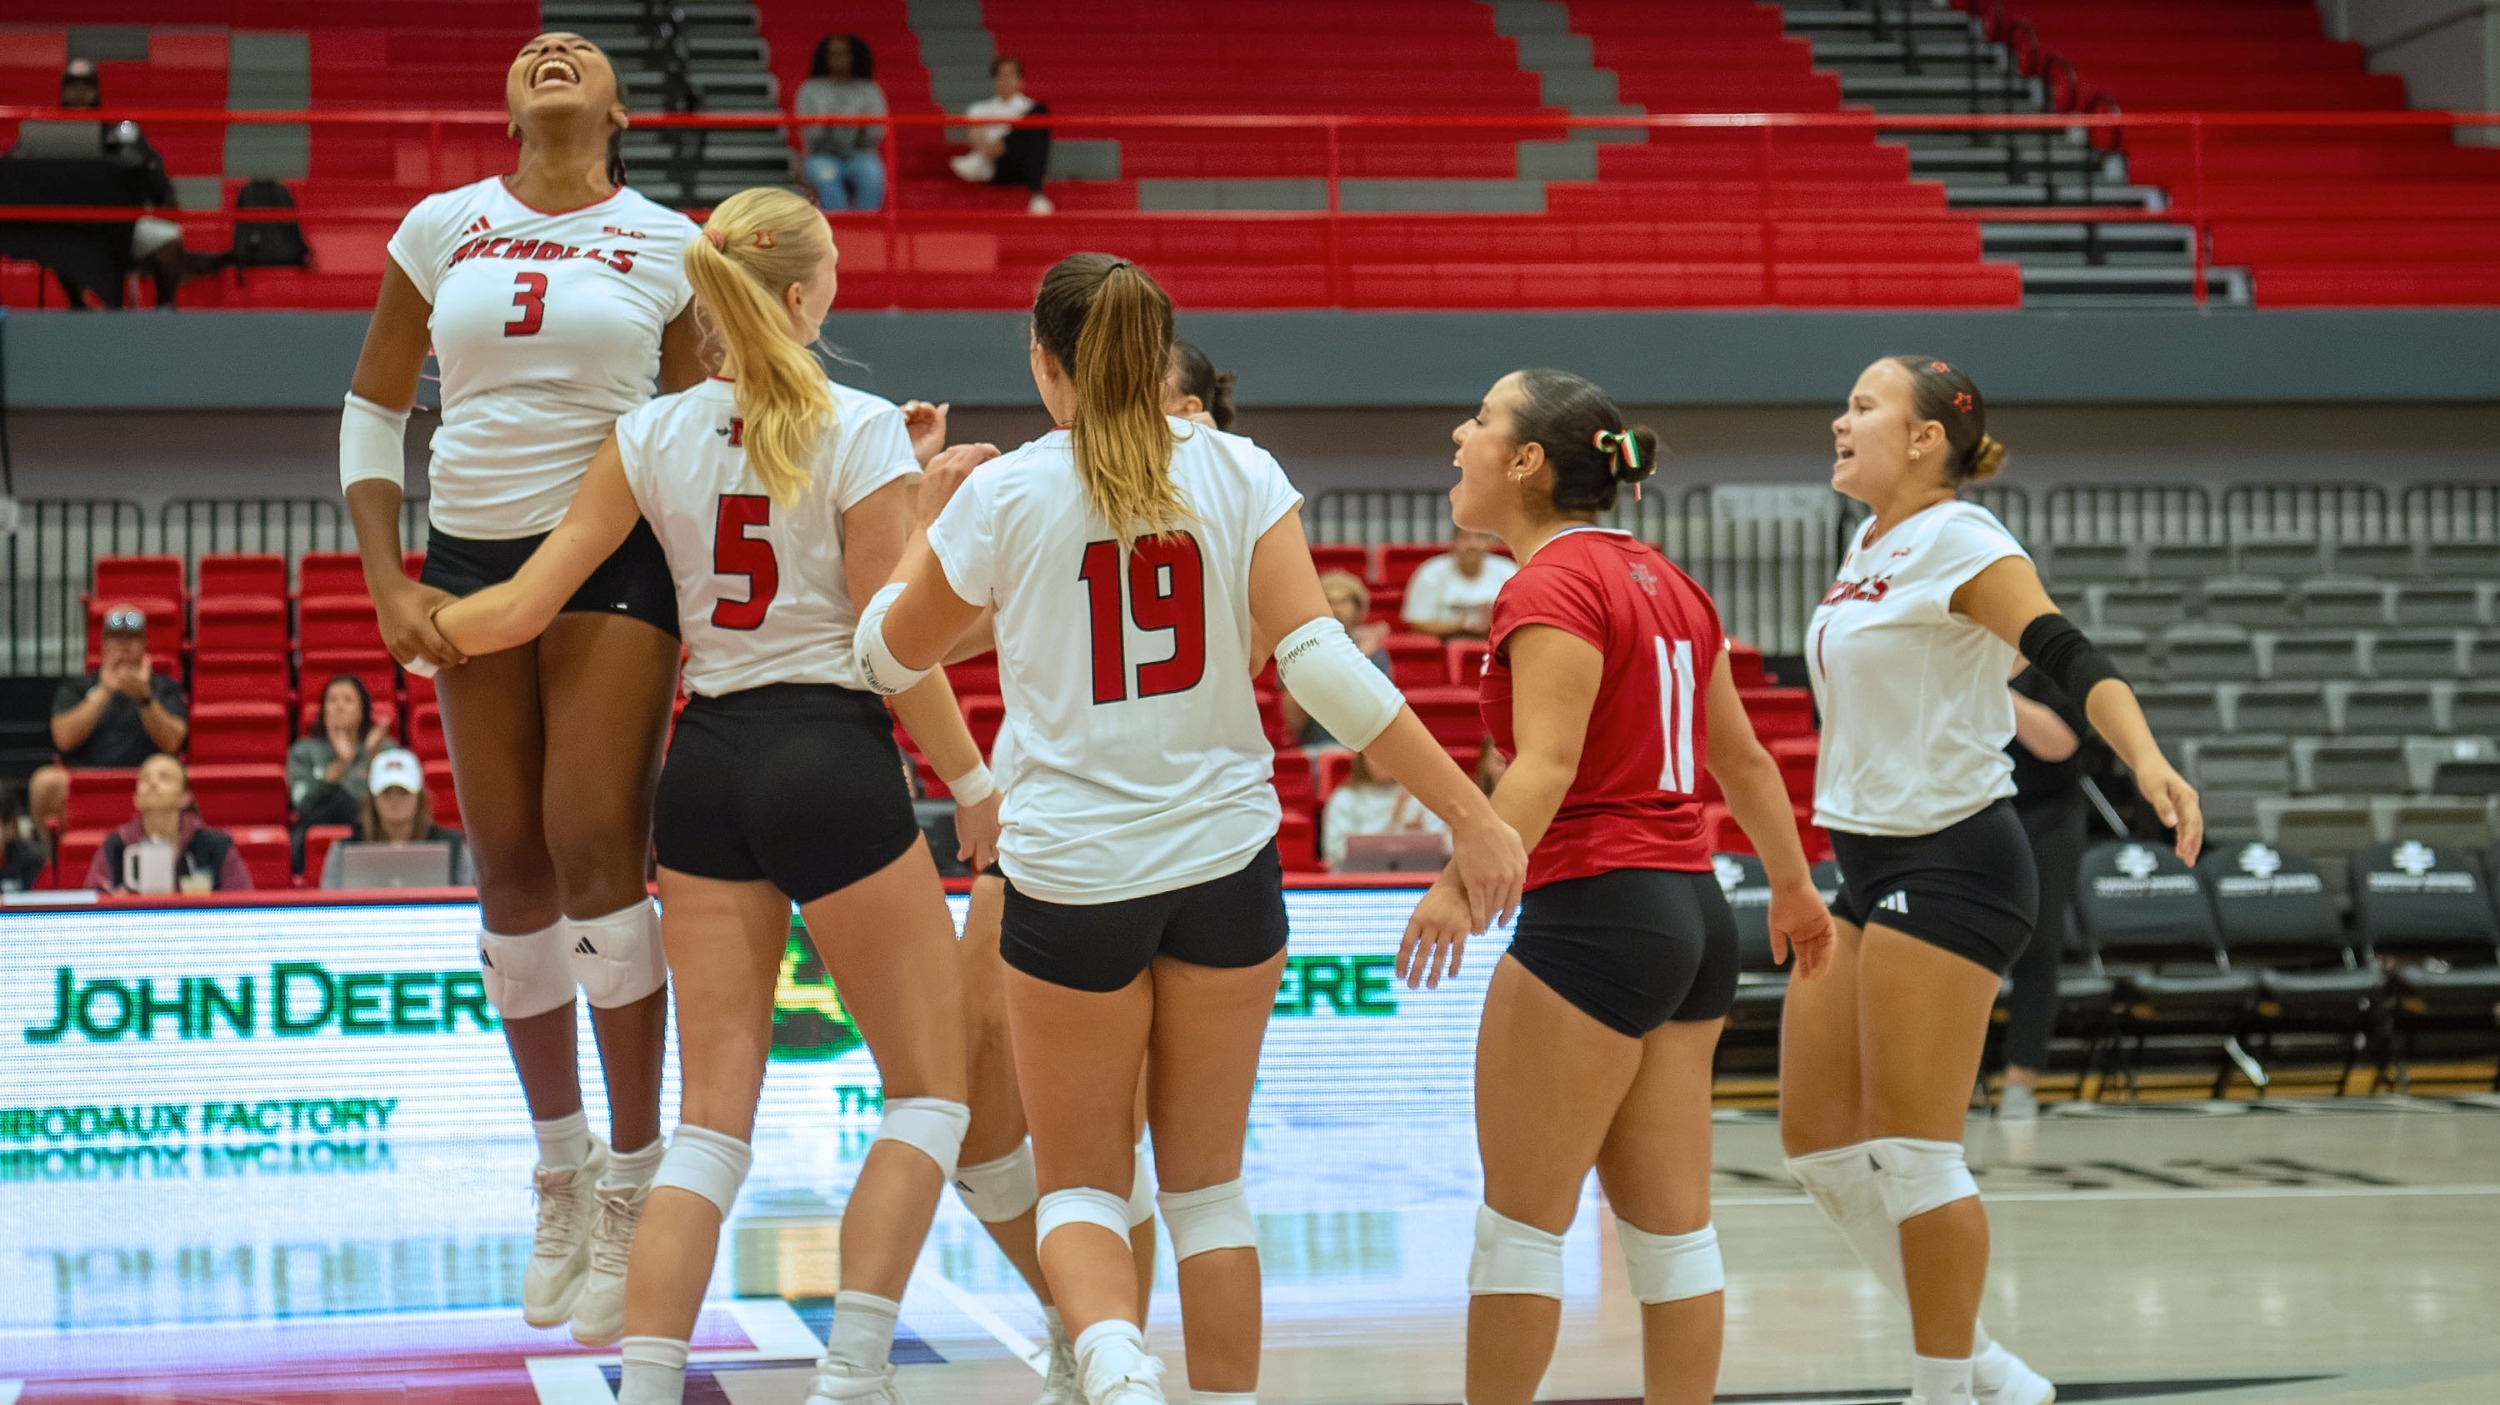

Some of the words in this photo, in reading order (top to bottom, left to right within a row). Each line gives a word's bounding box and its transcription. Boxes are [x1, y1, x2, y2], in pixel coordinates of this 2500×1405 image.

[504, 271, 548, 338] 3
[711, 494, 779, 631] 5
[1077, 529, 1206, 706] 19
[1654, 635, 1696, 794] 11
[23, 965, 256, 1043] JOHN
[271, 961, 502, 1037] DEER
[201, 1097, 398, 1136] FACTORY
